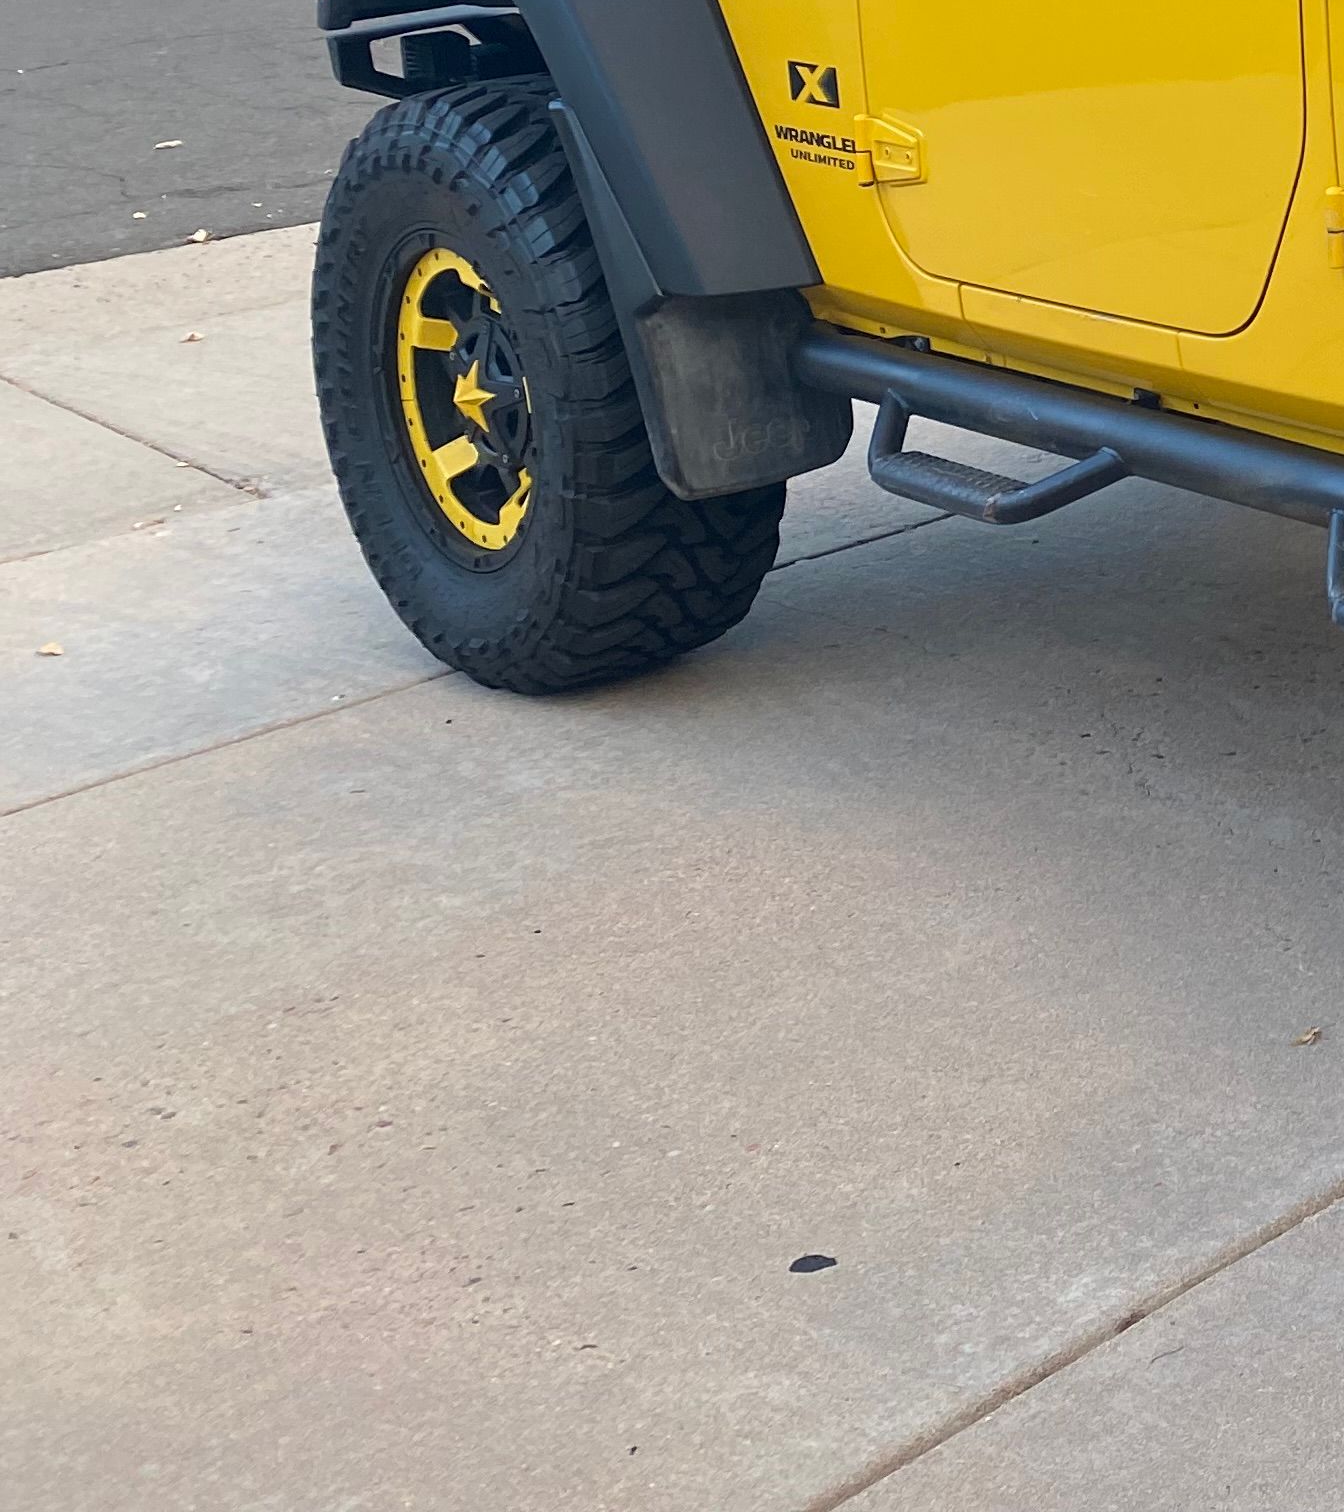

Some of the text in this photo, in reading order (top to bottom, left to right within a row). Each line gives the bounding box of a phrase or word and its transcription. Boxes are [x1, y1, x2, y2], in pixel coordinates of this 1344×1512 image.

[774, 124, 856, 154] WRANGLE
[790, 148, 856, 170] UNLIMITED
[713, 416, 810, 462] Jeep
